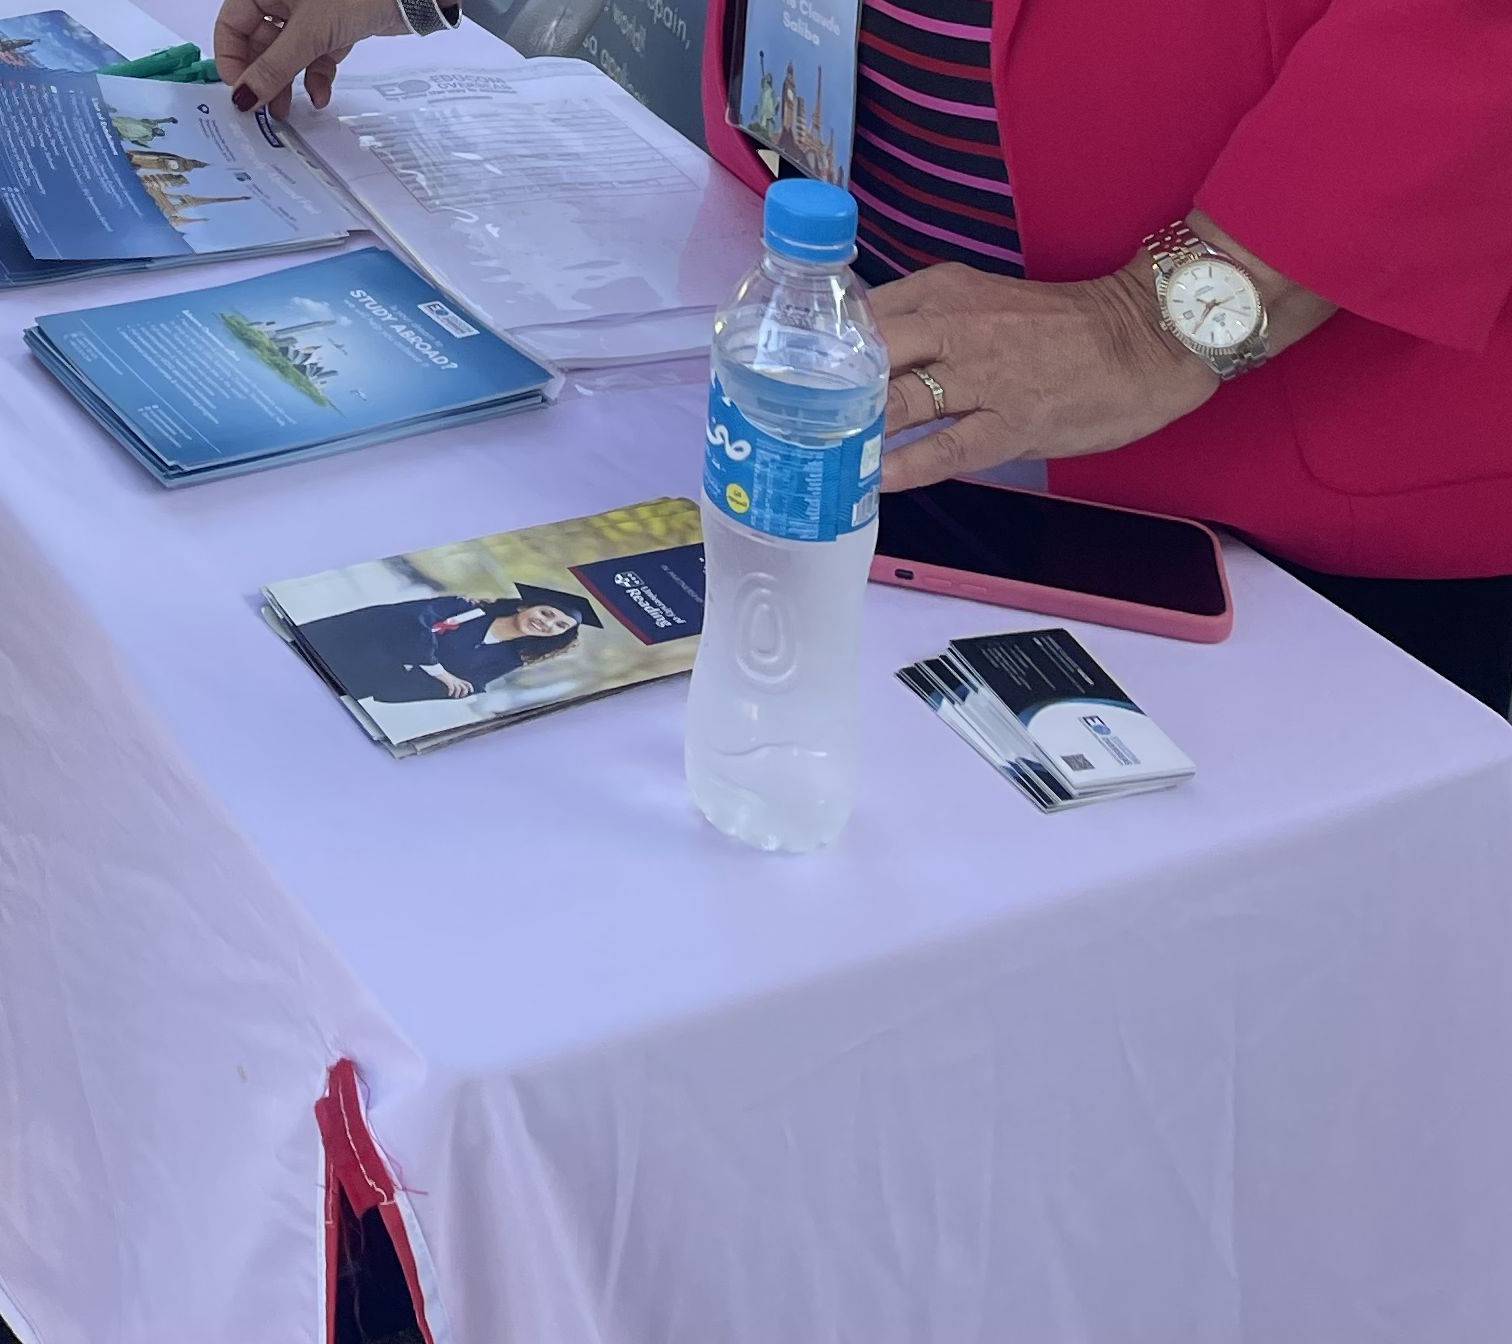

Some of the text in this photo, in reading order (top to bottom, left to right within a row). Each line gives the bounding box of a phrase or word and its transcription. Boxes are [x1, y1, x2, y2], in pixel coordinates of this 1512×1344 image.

[350, 289, 398, 322] STUDY
[390, 324, 458, 371] ABROAD?
[626, 588, 672, 628] Reading
